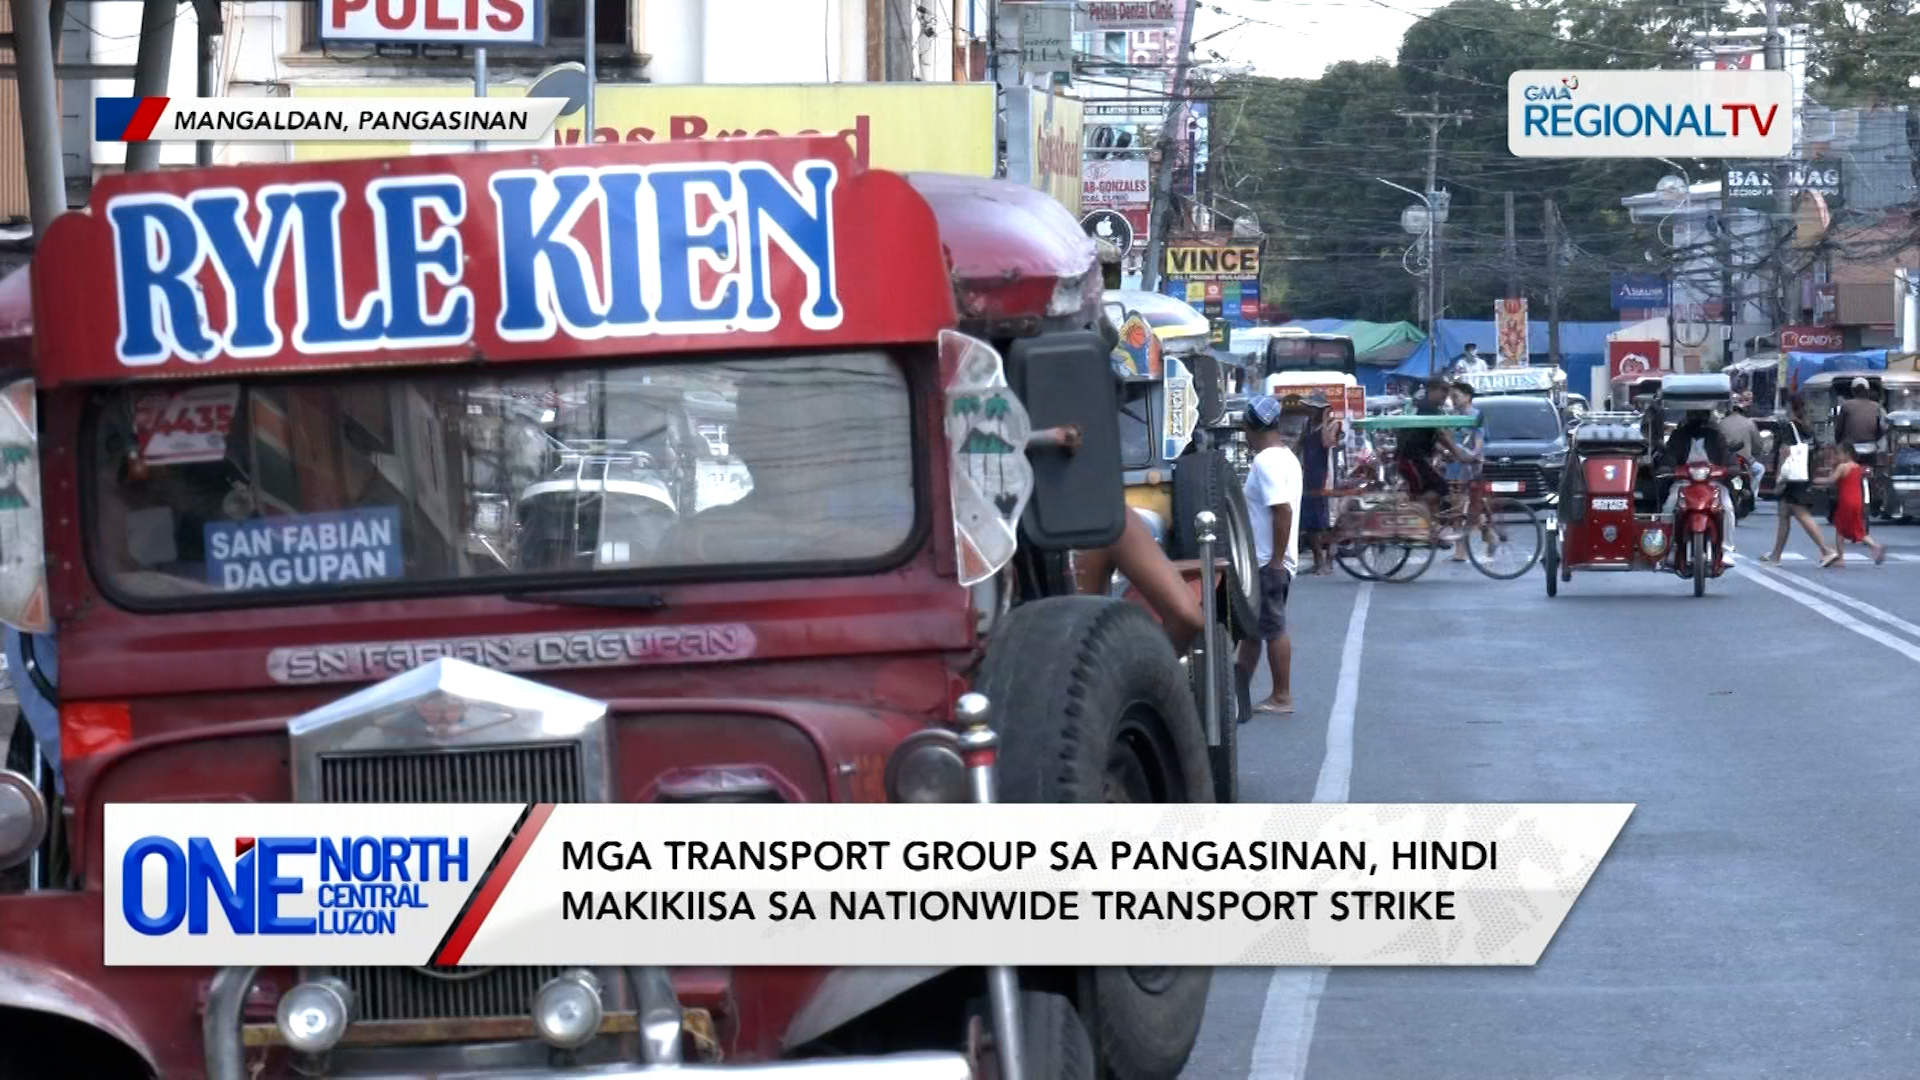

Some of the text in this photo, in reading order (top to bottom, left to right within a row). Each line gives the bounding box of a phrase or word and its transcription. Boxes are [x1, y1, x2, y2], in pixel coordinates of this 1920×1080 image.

[331, 0, 525, 32] PULIS
[107, 160, 846, 368] RYLE KIEN
[1169, 249, 1257, 272] VINCE
[211, 518, 393, 561] SAN FABIAN
[223, 550, 388, 593] DAGUPAN
